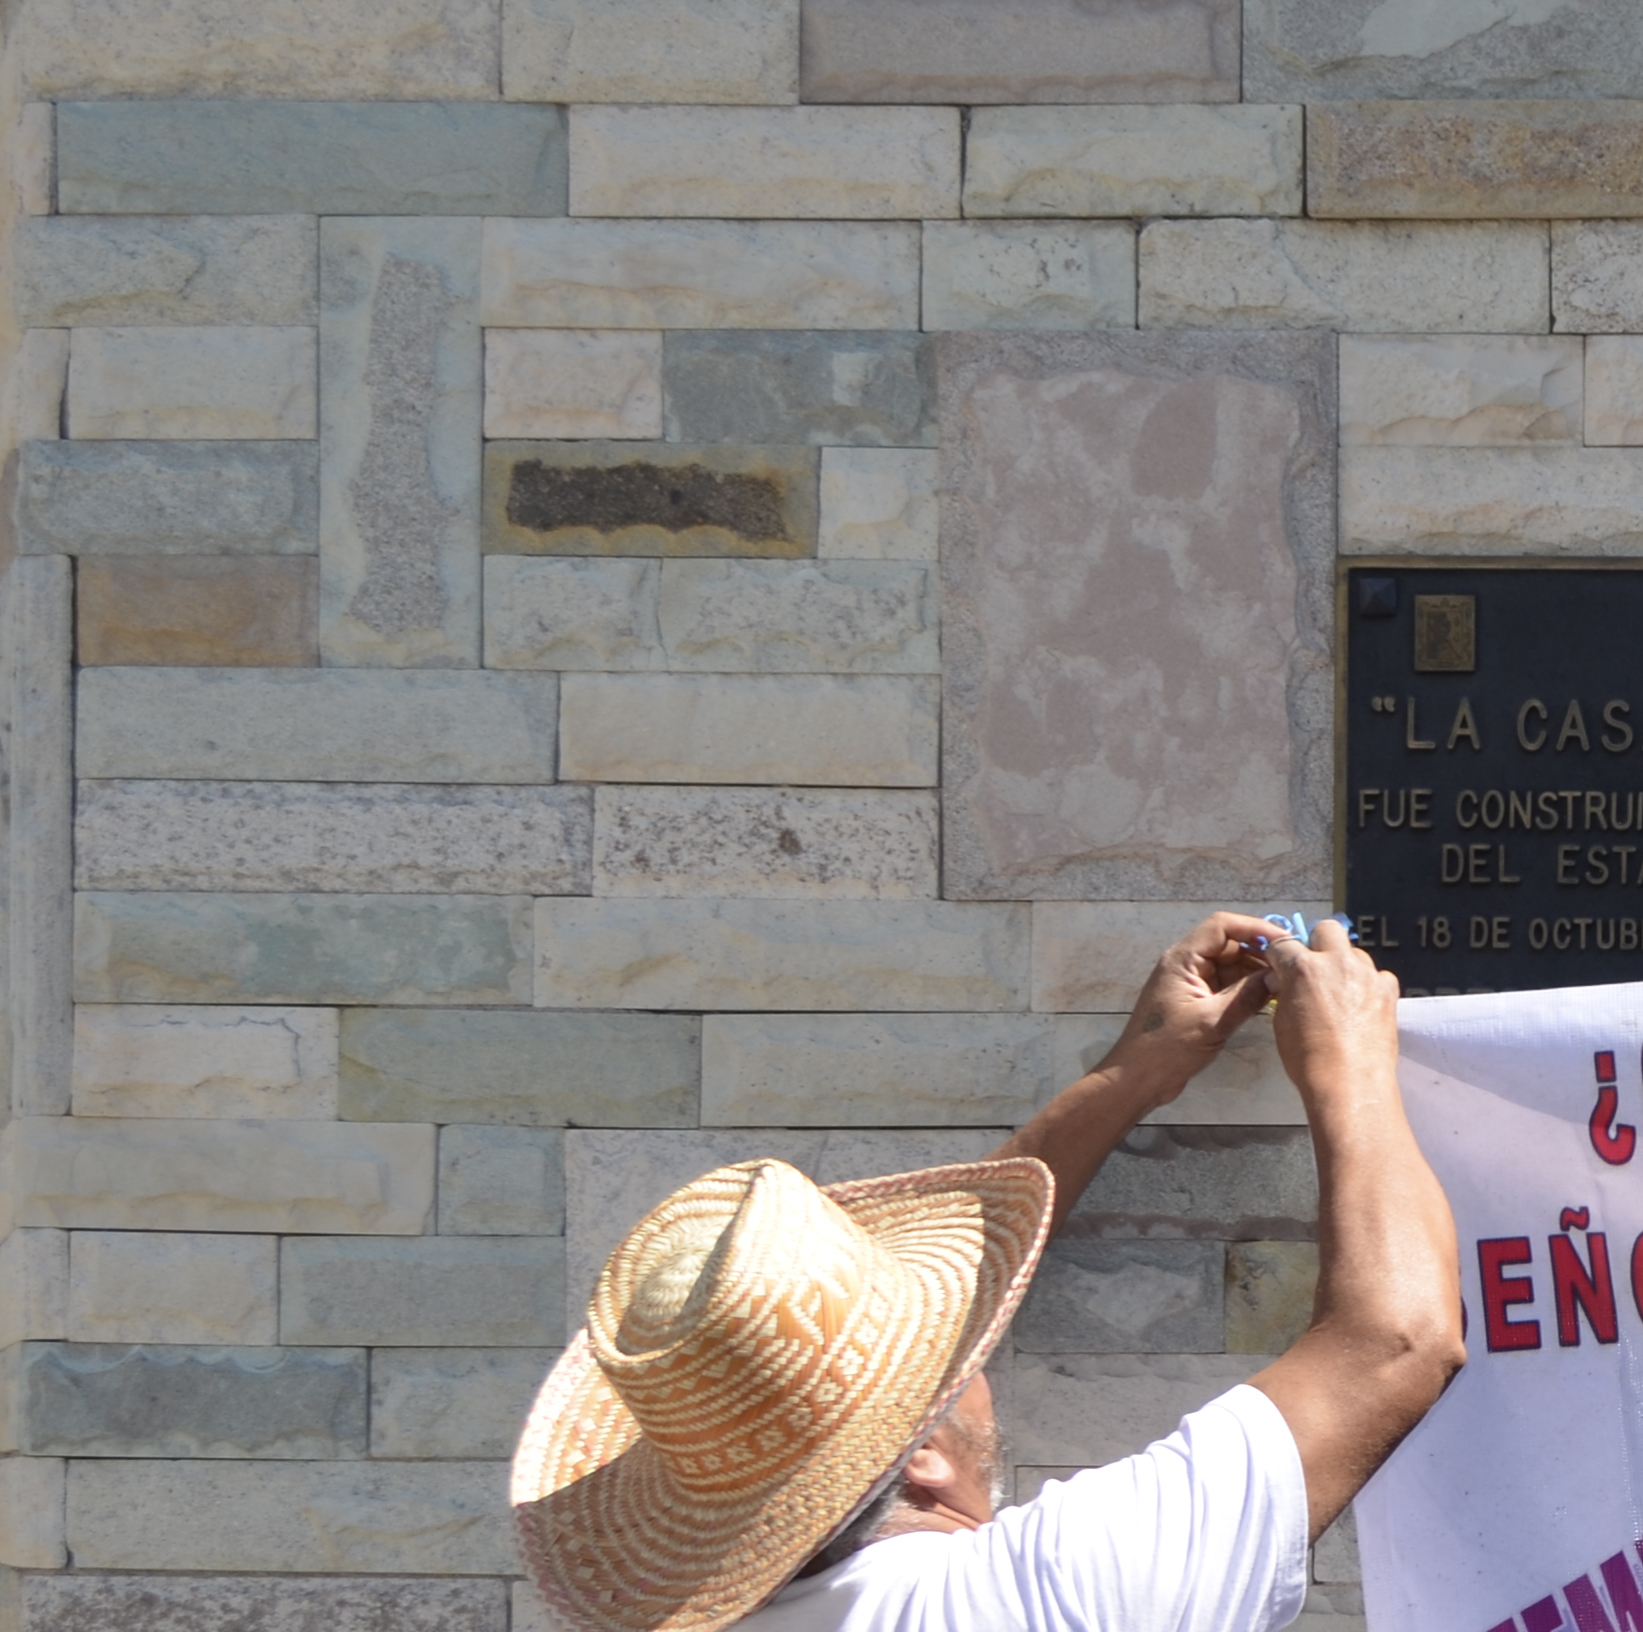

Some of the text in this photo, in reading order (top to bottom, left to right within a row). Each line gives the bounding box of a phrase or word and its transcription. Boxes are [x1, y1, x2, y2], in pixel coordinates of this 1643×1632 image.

[1358, 788, 1434, 829] FUE
[1441, 844, 1522, 884] DEL
[1358, 916, 1400, 947] EL
[1416, 916, 1452, 949] 18
[1469, 917, 1511, 949] DE
